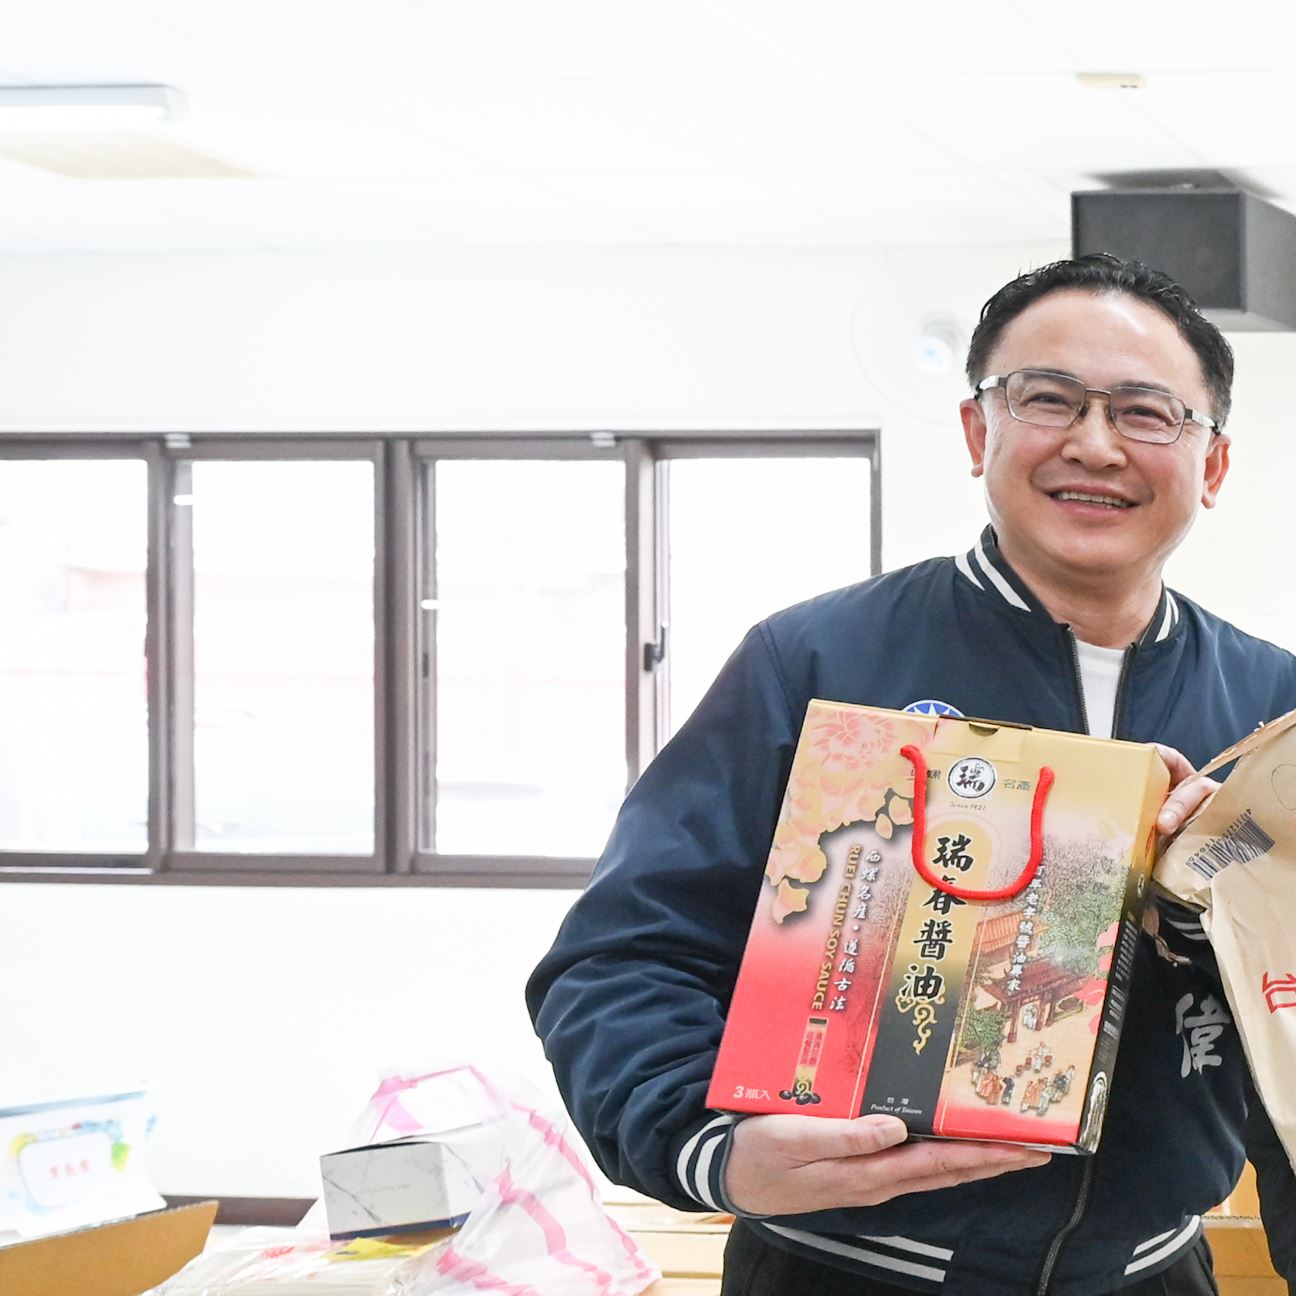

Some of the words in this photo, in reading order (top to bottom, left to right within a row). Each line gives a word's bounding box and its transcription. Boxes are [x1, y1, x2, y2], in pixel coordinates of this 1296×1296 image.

[845, 844, 861, 879] RUEI
[832, 884, 852, 926] CHUN
[898, 833, 975, 1001] 瑞春醬油
[825, 930, 840, 960] SOY
[812, 962, 832, 1010] SAUCE
